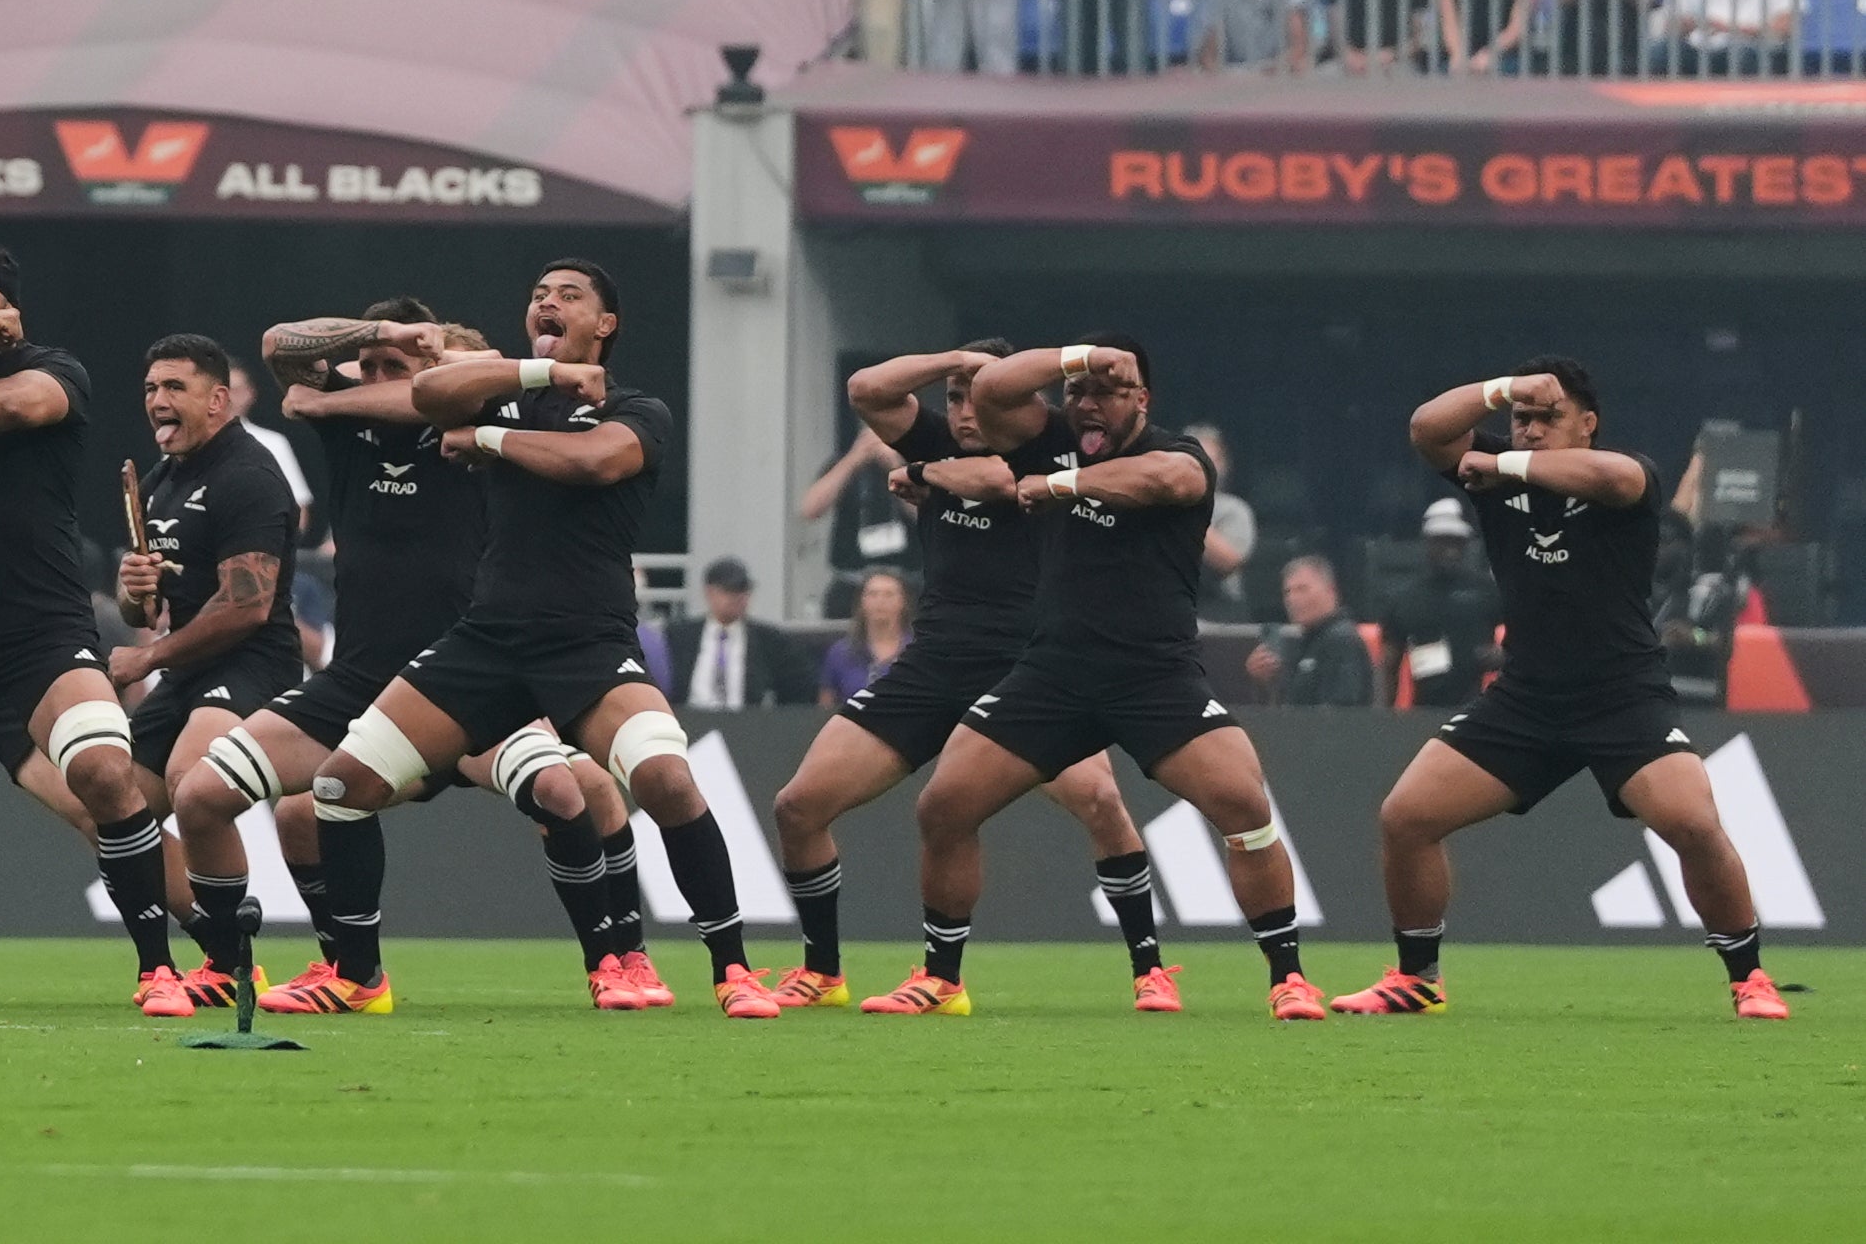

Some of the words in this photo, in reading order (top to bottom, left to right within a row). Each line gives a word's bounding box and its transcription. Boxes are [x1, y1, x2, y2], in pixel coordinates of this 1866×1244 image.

[215, 161, 320, 201] ALL
[326, 164, 543, 205] BLACKS
[1108, 150, 1461, 203] RUGBY'S
[368, 479, 418, 495] ALTRAD
[940, 509, 991, 530] ALTRAD
[1070, 503, 1116, 527] ALTRAD
[147, 537, 180, 552] ALTRAD
[1525, 545, 1570, 564] ALTRAD
